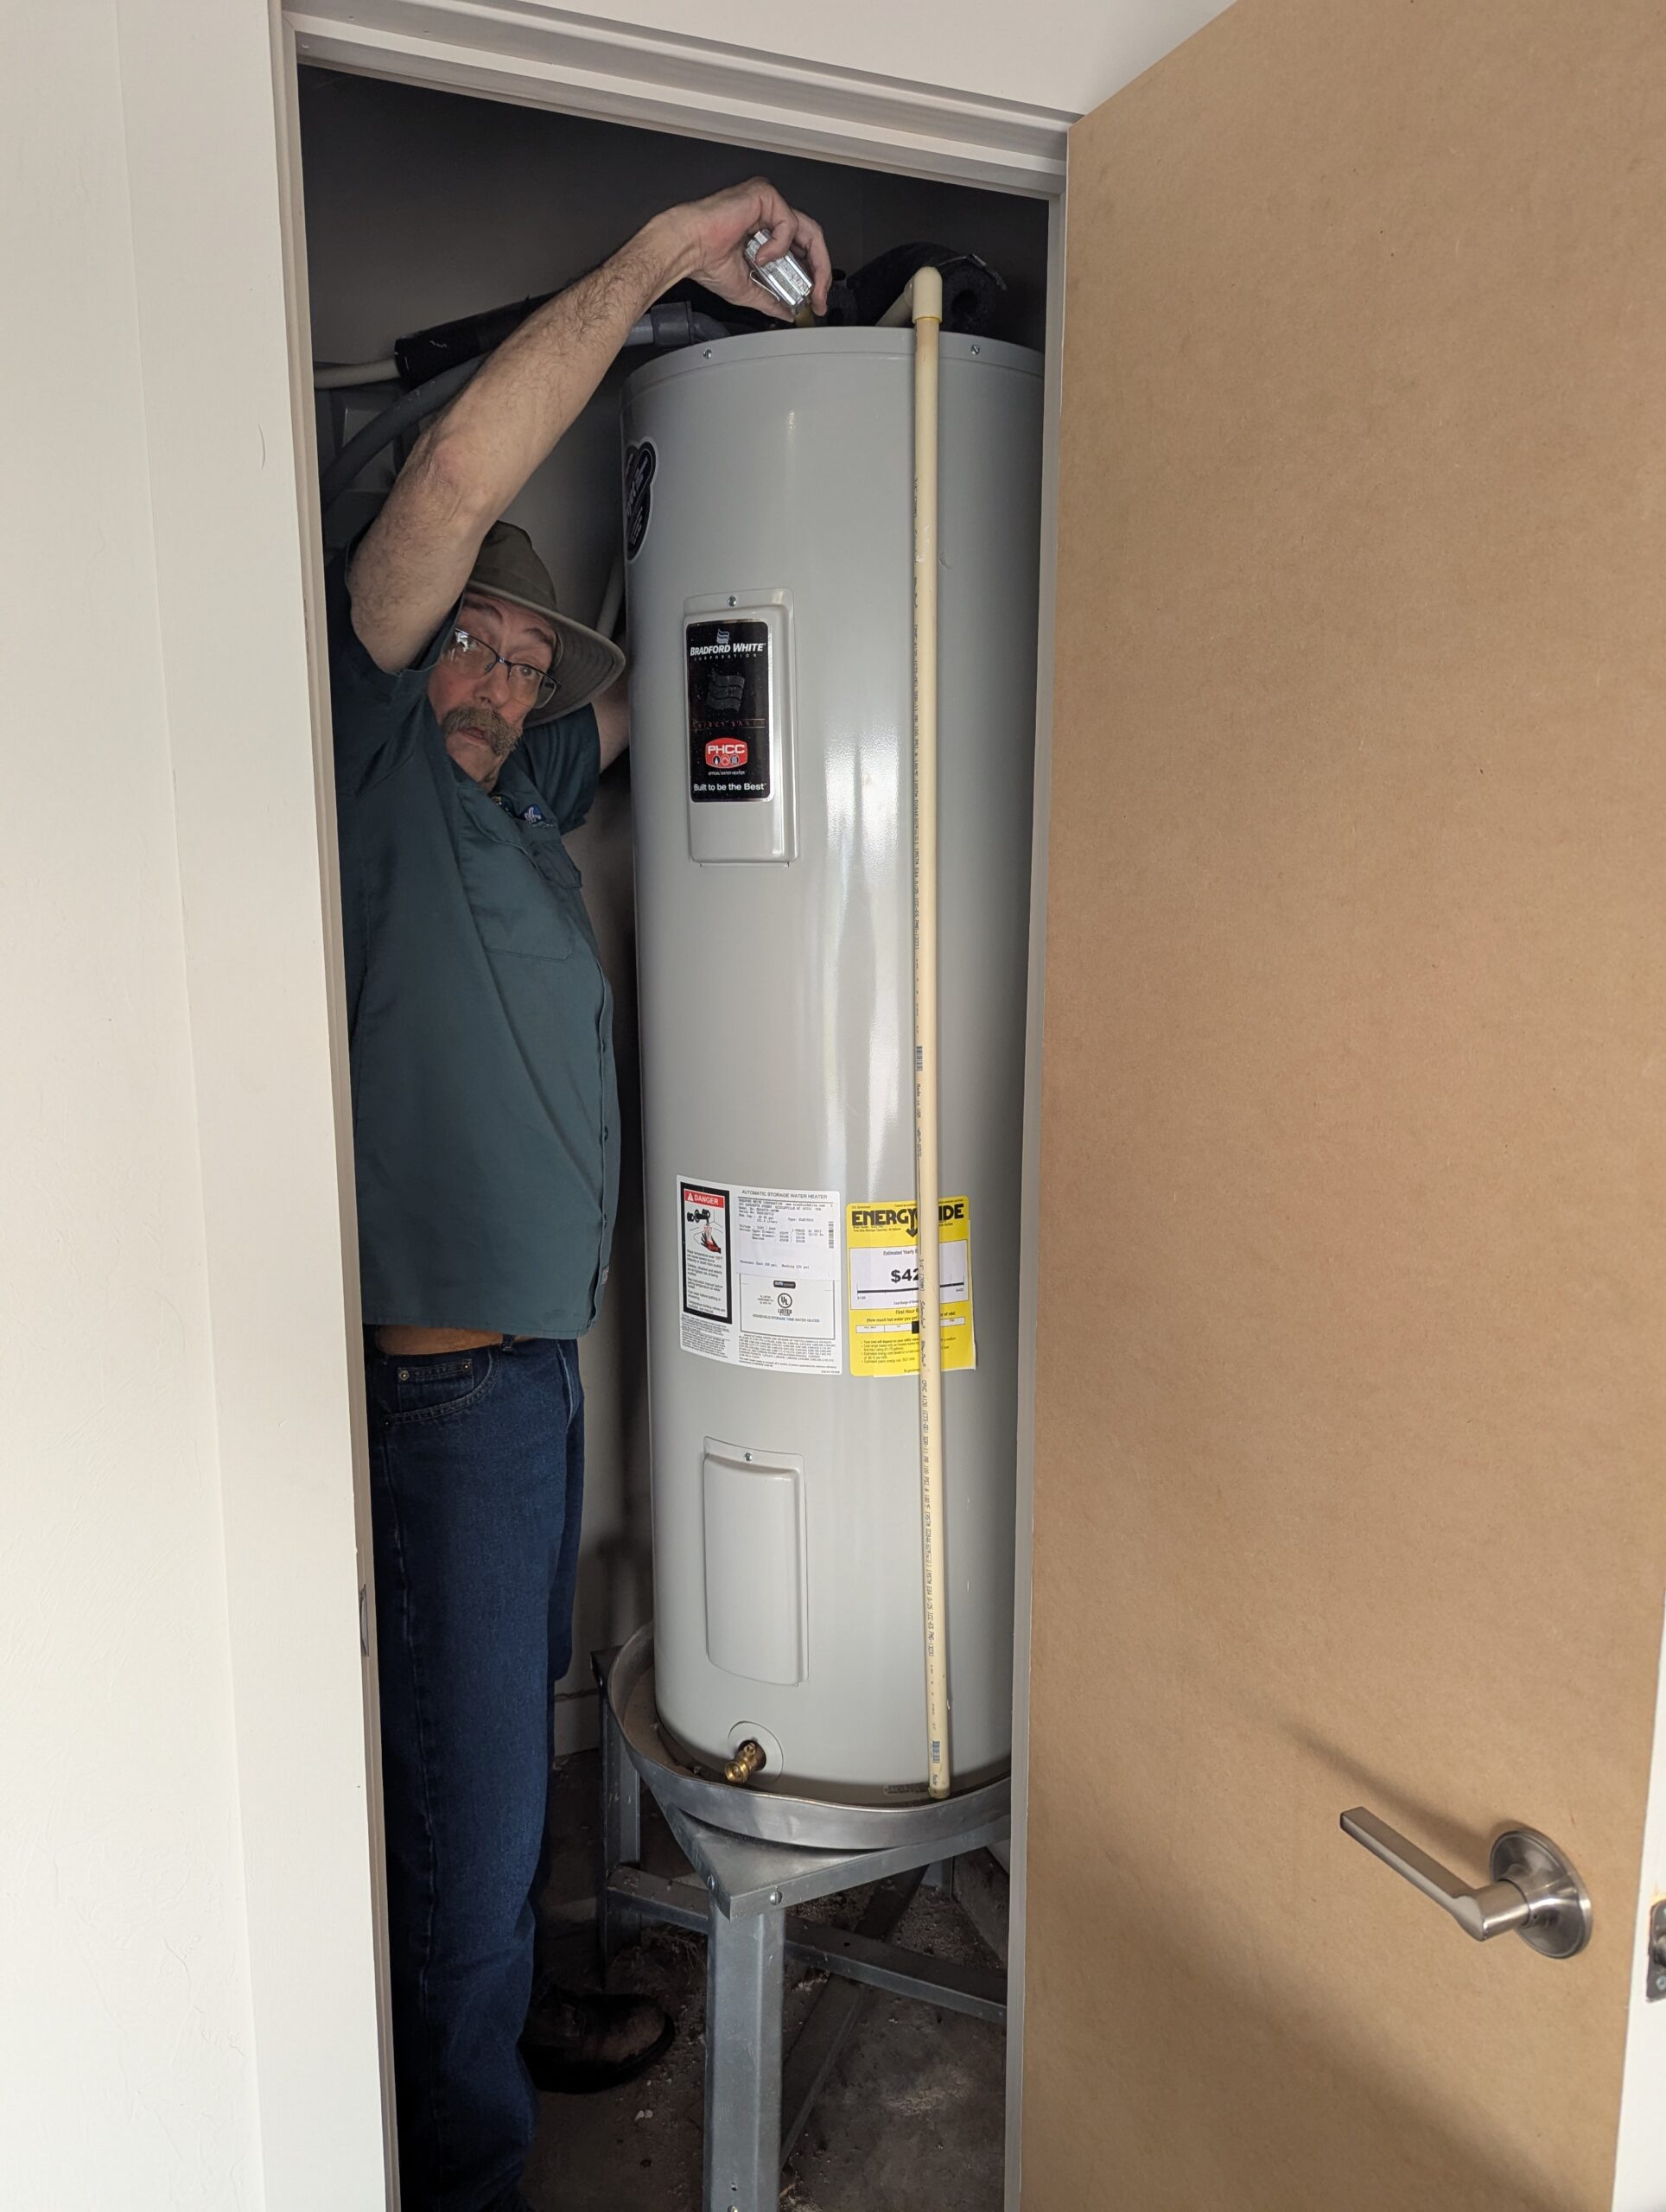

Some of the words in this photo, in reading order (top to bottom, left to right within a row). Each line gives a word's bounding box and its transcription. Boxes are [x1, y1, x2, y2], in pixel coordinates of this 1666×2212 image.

[690, 645, 730, 656] BRADFORD
[694, 653, 757, 662] CORPORATION
[708, 744, 746, 754] PHCC
[694, 1195, 719, 1205] DANGER
[780, 1295, 789, 1306] UL
